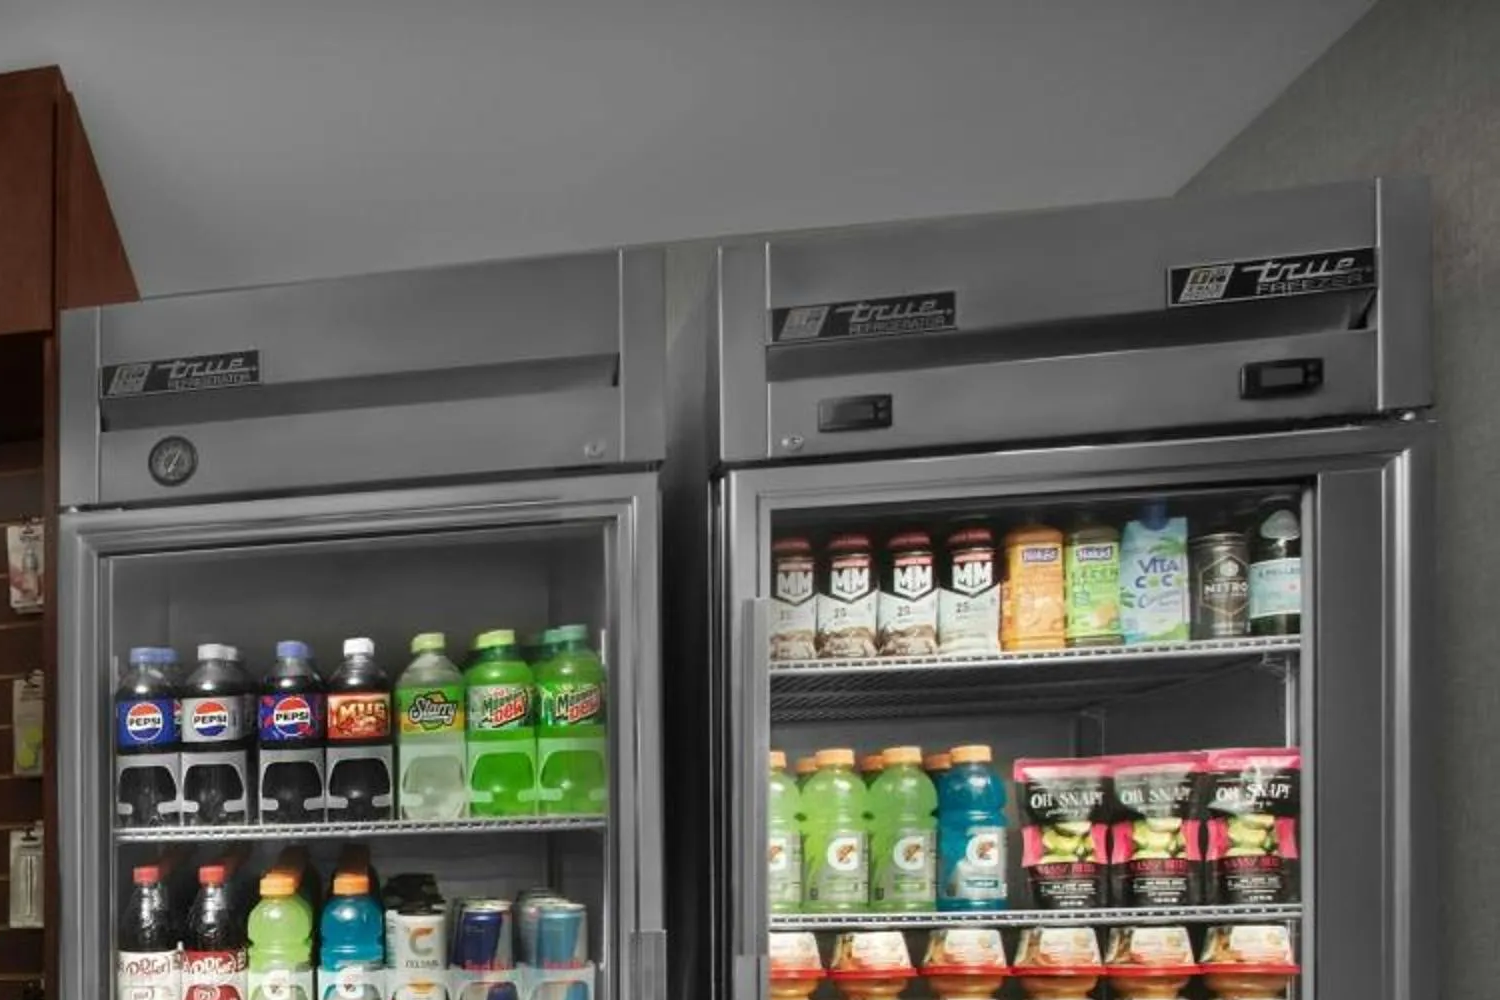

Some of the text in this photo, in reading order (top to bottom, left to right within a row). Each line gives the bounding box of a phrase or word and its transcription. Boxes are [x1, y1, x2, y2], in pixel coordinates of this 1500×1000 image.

[1255, 273, 1363, 295] FREEZER
[1139, 557, 1180, 574] VITA
[1203, 582, 1249, 596] NITRO
[275, 711, 311, 723] PEPSI
[338, 701, 387, 719] MUG
[408, 695, 457, 725] Starry
[129, 716, 162, 727] PEPSI
[193, 714, 228, 726] PEPSI
[1030, 792, 1053, 811] OH
[1120, 788, 1145, 806] OH
[1215, 786, 1240, 803] OH
